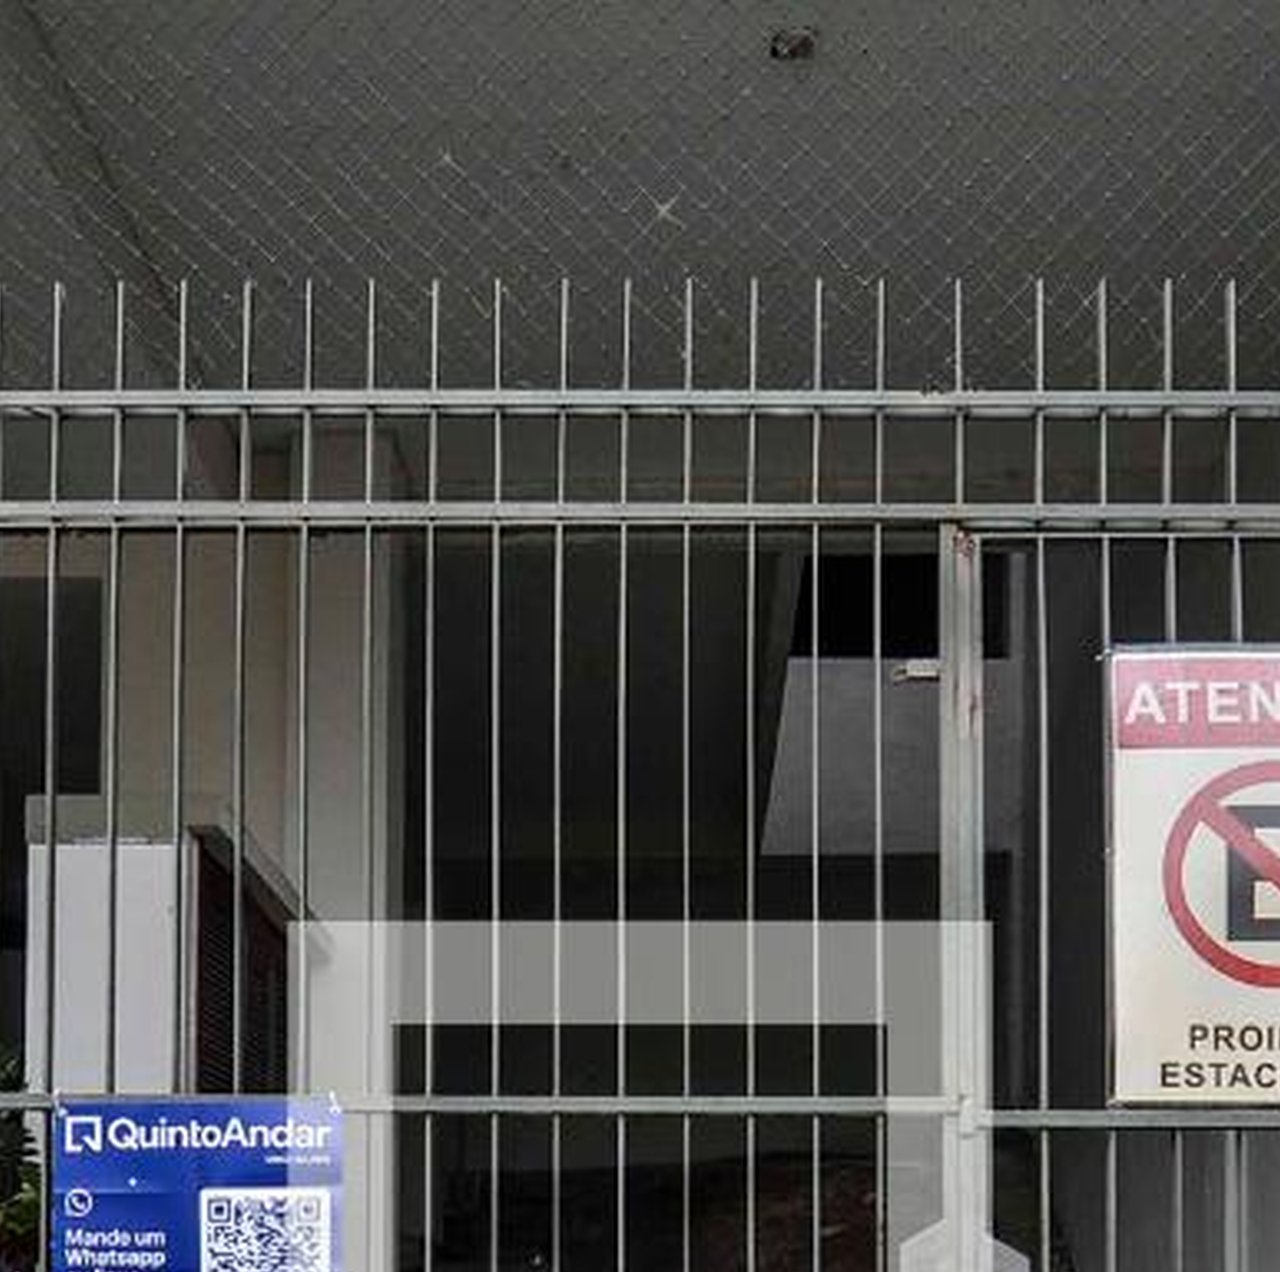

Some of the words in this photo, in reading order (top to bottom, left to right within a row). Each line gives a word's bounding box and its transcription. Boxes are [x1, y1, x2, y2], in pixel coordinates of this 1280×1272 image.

[107, 1116, 332, 1151] QuintoAndar
[65, 1228, 131, 1247] Mande
[134, 1231, 166, 1247] um
[64, 1249, 166, 1270] Whatsapp
